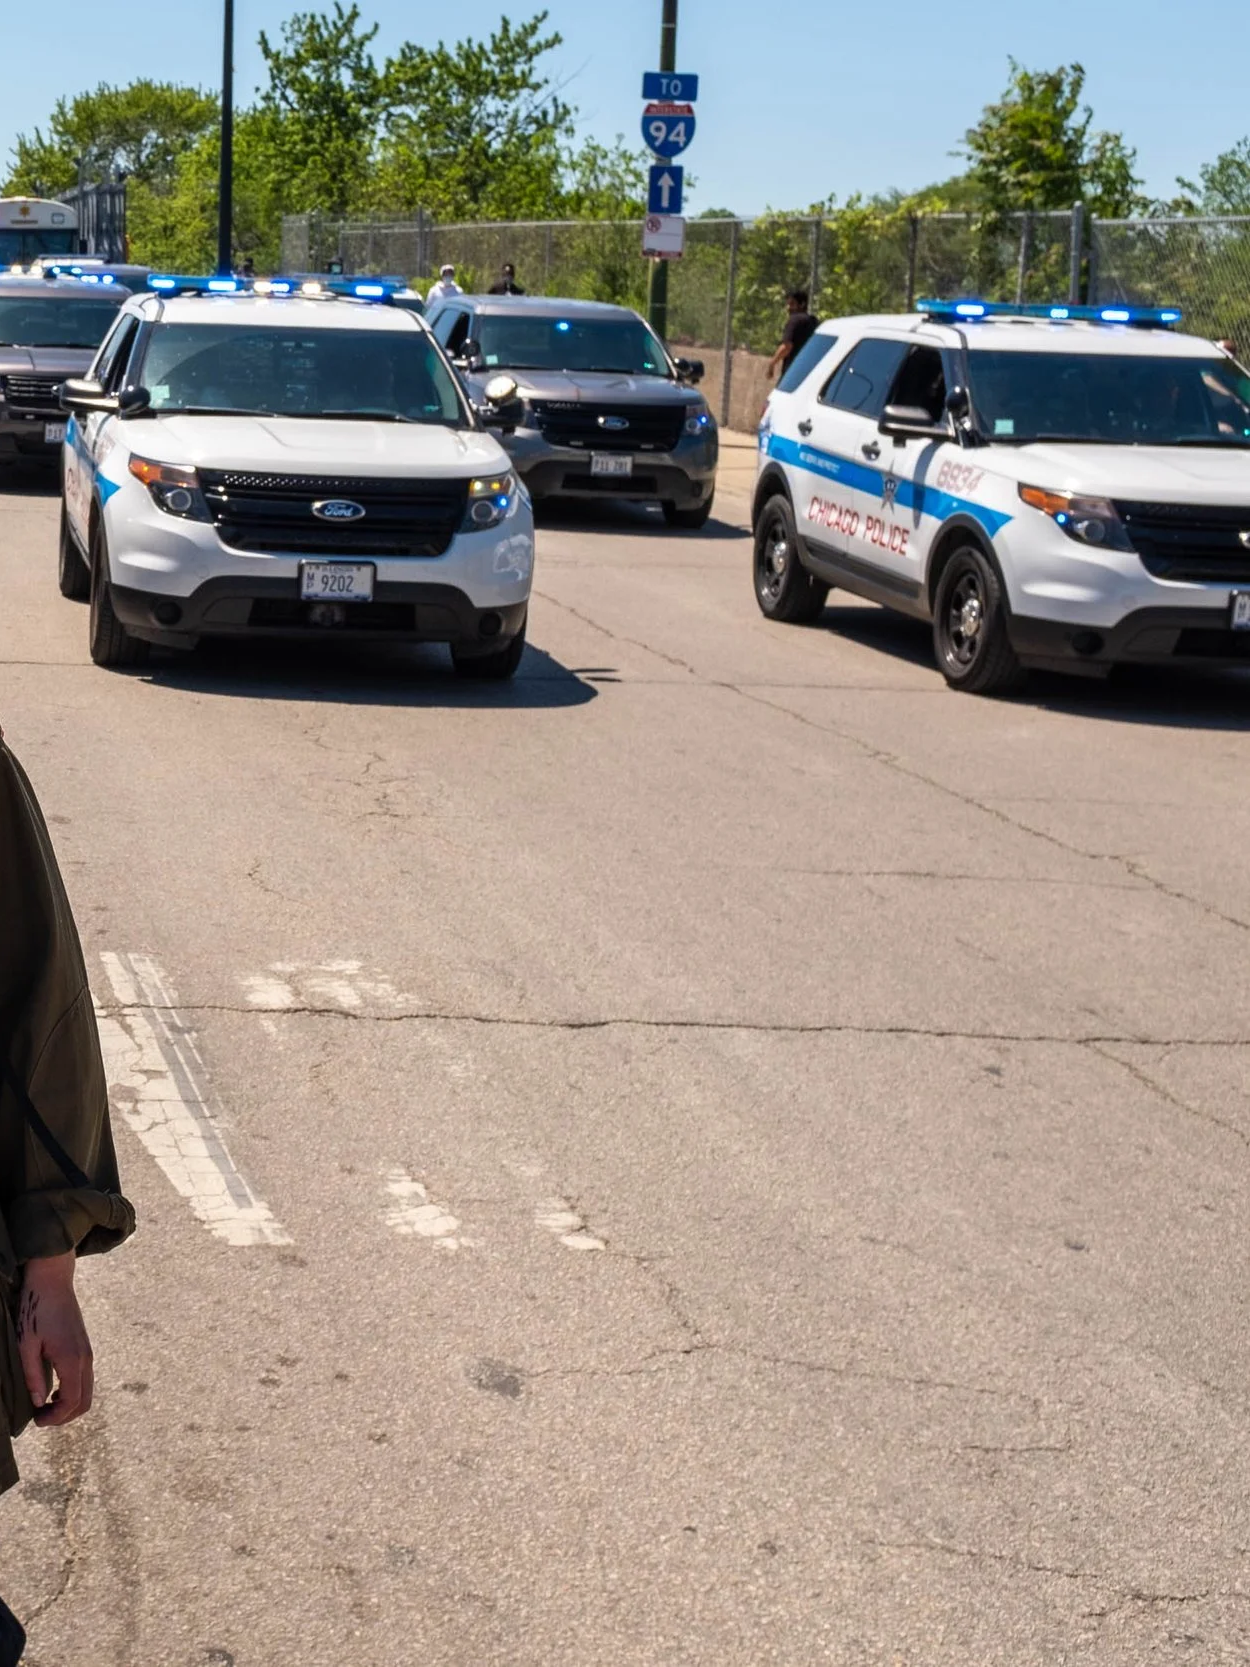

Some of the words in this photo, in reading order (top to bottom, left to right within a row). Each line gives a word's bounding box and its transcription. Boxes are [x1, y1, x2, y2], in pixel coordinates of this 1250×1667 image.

[659, 78, 683, 97] TO
[648, 119, 687, 148] 94
[324, 503, 354, 517] Ford
[807, 496, 860, 537] CHICAGO
[865, 515, 911, 555] POLICE
[321, 574, 355, 593] 9202
